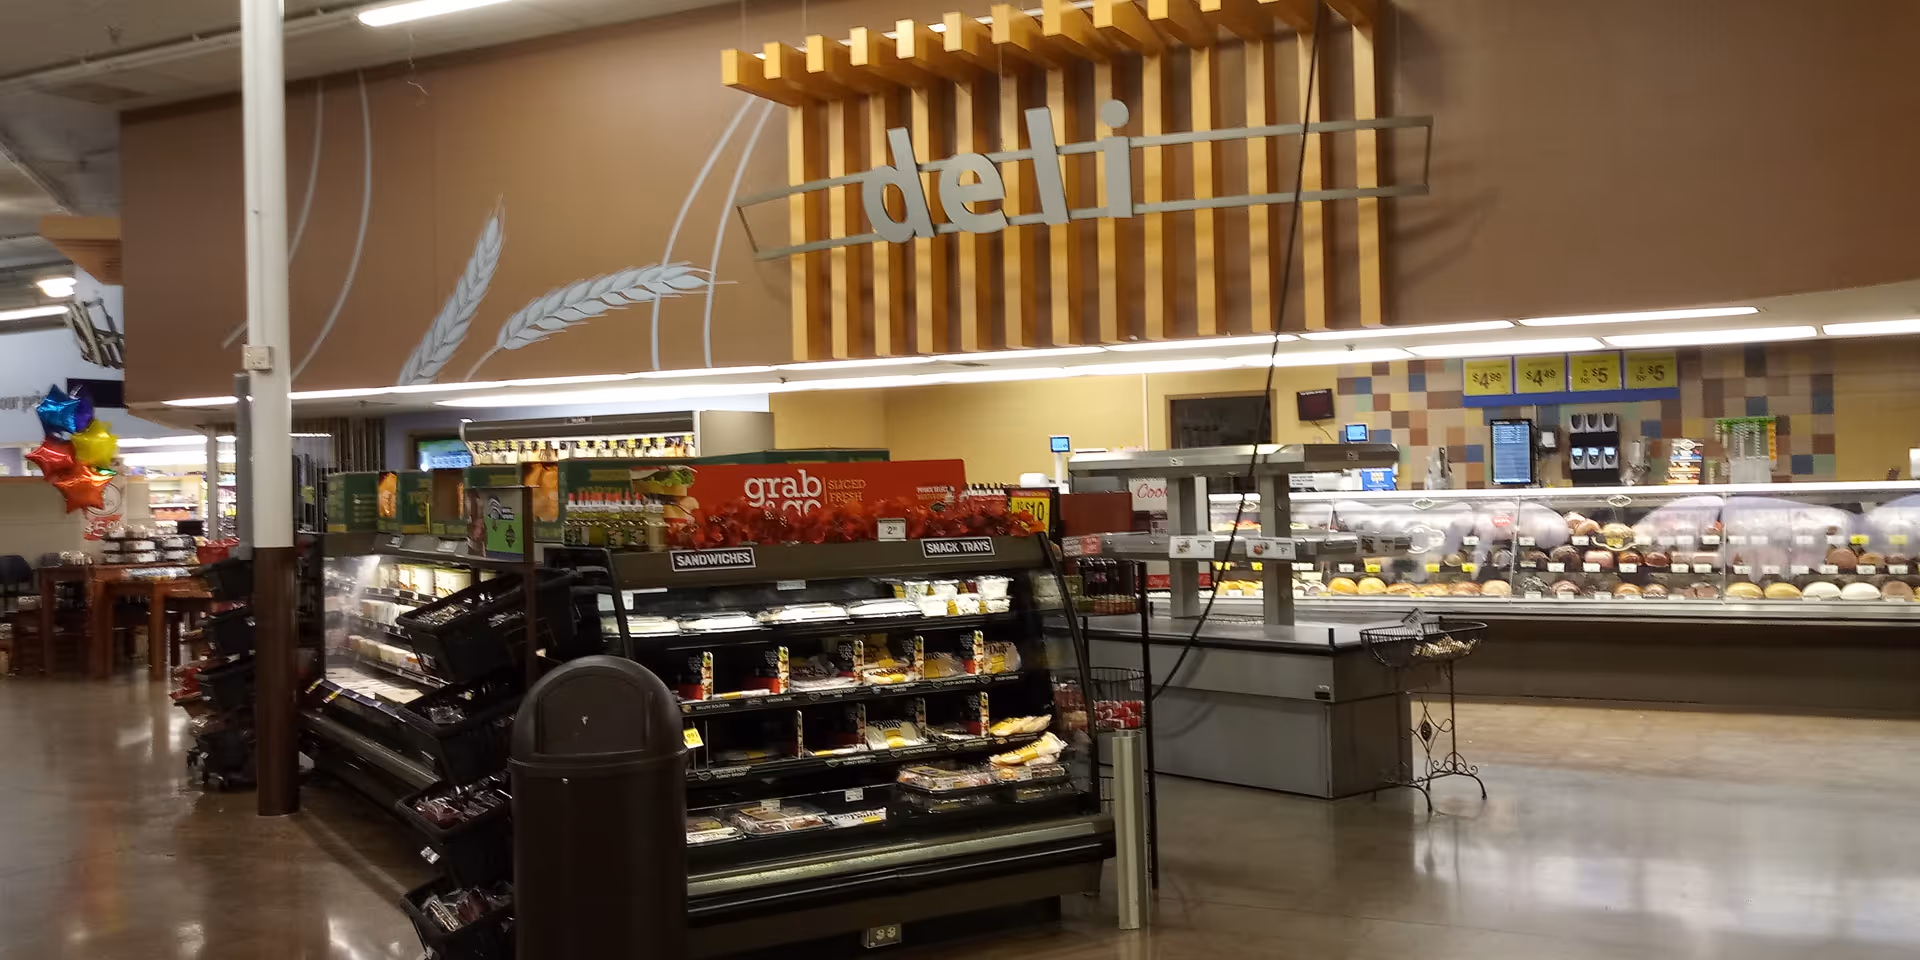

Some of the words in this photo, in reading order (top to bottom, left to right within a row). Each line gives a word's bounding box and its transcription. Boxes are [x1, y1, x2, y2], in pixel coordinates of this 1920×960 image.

[862, 99, 1133, 243] deli
[744, 468, 822, 508] grab
[828, 479, 866, 490] SLICED
[926, 542, 960, 554] SNACK
[960, 540, 991, 552] TRAYS
[676, 552, 751, 567] SANDWICHES
